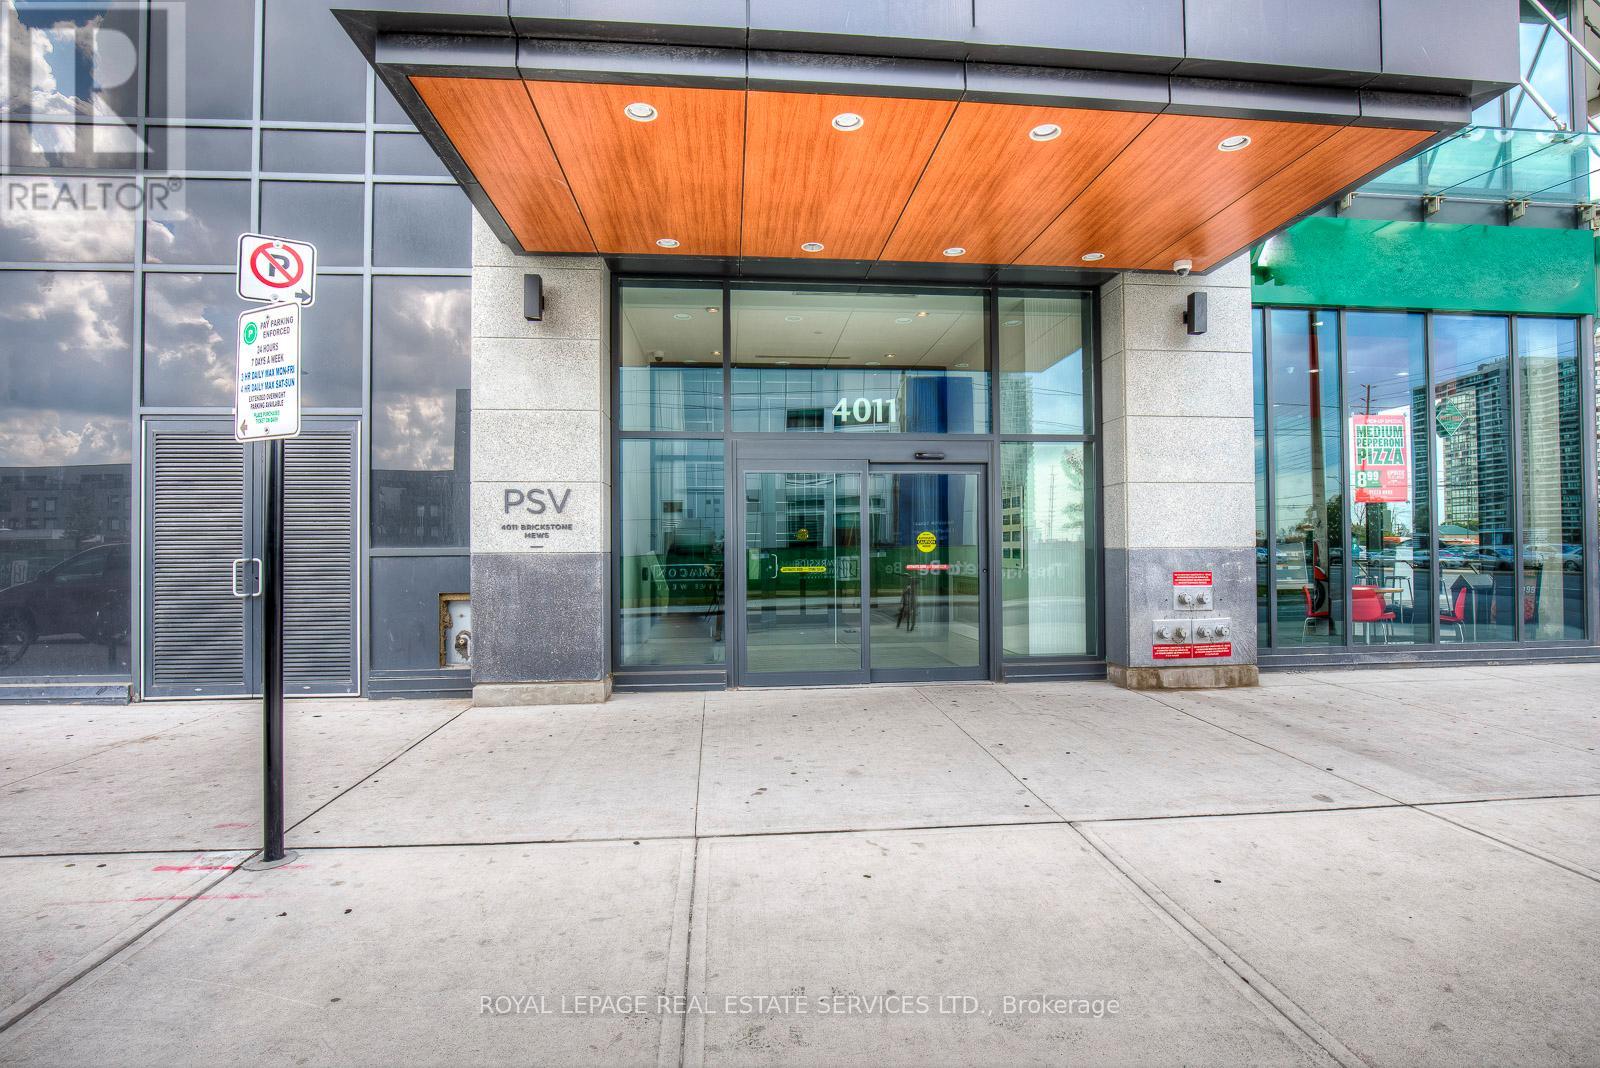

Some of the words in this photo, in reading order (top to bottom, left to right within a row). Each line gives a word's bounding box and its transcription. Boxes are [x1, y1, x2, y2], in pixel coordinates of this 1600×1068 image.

[260, 320, 270, 330] PAY
[271, 316, 294, 328] PARKING
[263, 327, 291, 339] ENFORCED
[263, 342, 279, 353] HOURS
[255, 356, 266, 366] DAYS
[271, 354, 285, 364] WEEK
[244, 371, 251, 381] HR
[252, 370, 264, 380] DAILY
[265, 368, 275, 378] MAX
[275, 365, 295, 377] MON-FRI
[244, 384, 251, 392] HR
[252, 382, 264, 392] DAILY
[265, 380, 275, 390] MAX
[275, 379, 295, 389] SAT-SUN
[250, 402, 265, 410] PARKING
[832, 397, 897, 423] 4011
[1356, 425, 1403, 438] MEDIUM
[1356, 438, 1404, 447] PEPPERONI
[1357, 447, 1404, 465] PIZZA
[504, 488, 572, 514] PSV
